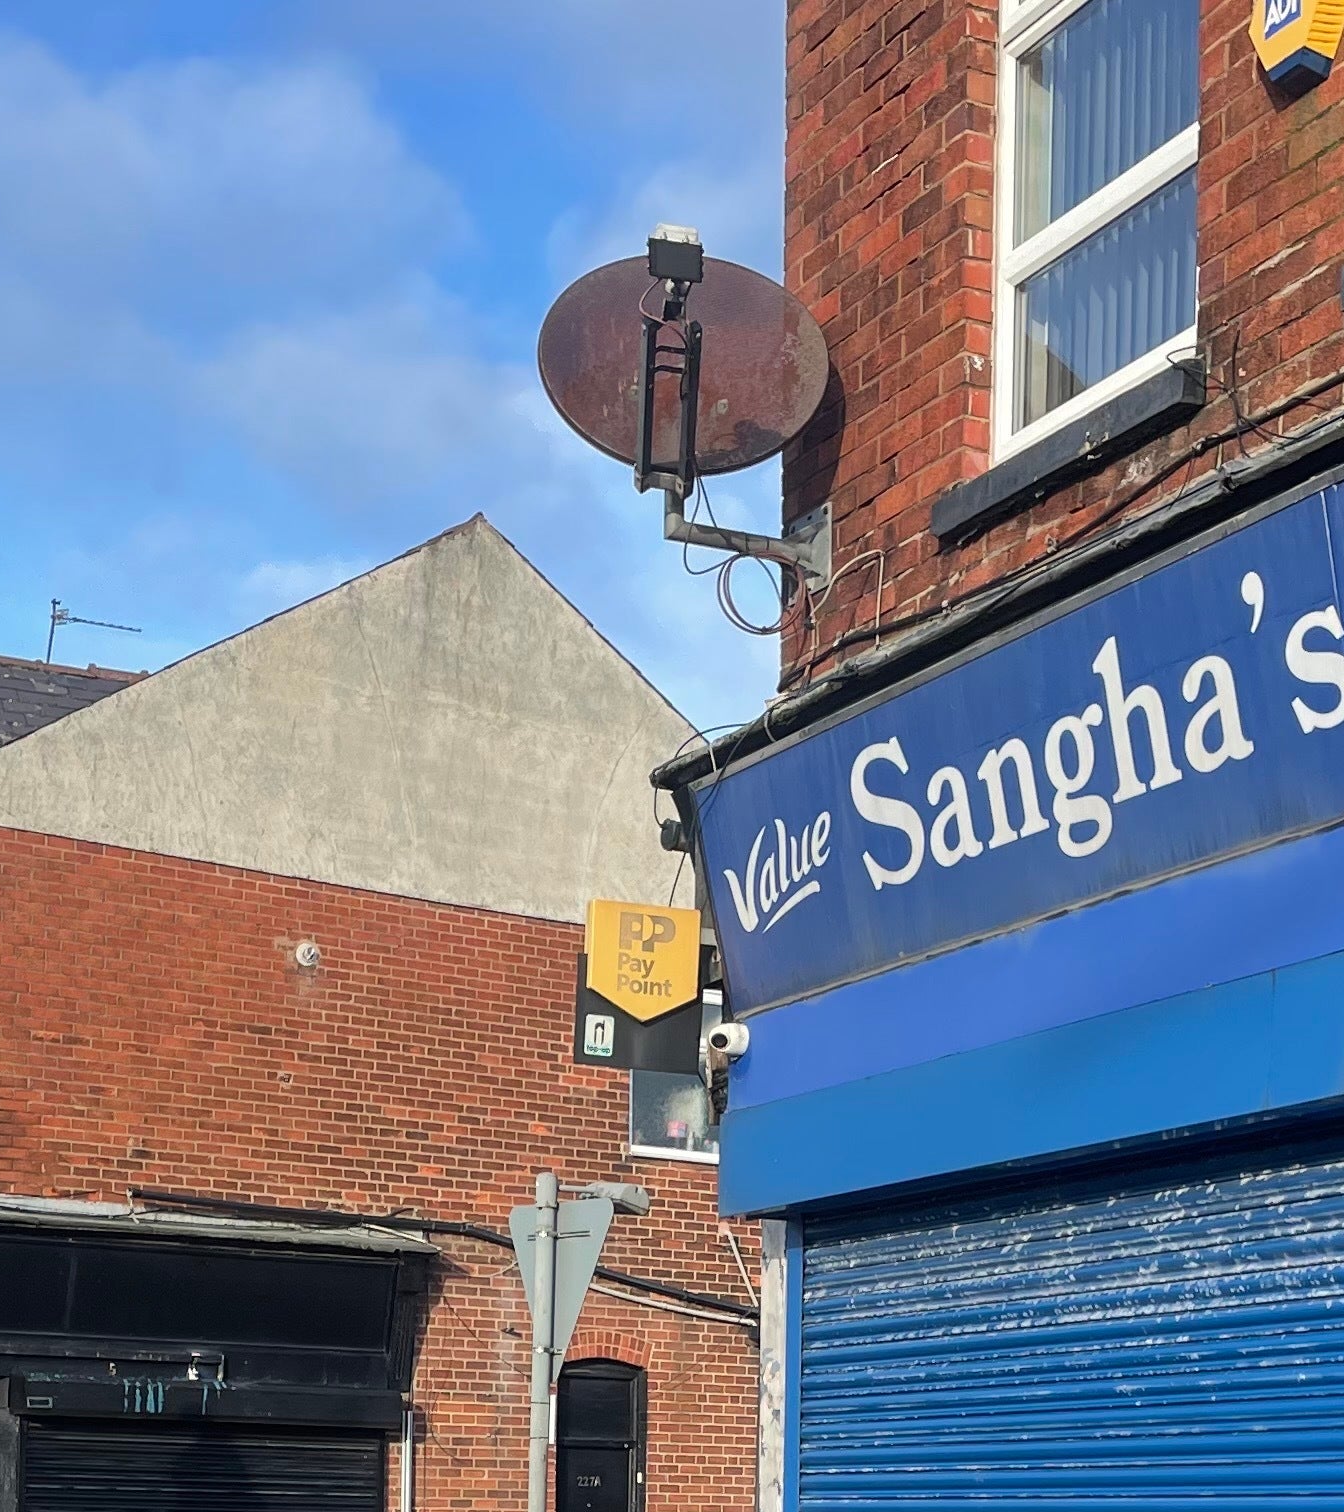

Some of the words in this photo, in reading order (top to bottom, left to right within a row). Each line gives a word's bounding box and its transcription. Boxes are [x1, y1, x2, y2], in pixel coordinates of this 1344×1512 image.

[723, 810, 832, 934] Value
[618, 952, 655, 978] Pay
[617, 973, 672, 997] Point
[576, 1476, 601, 1487] 227A
